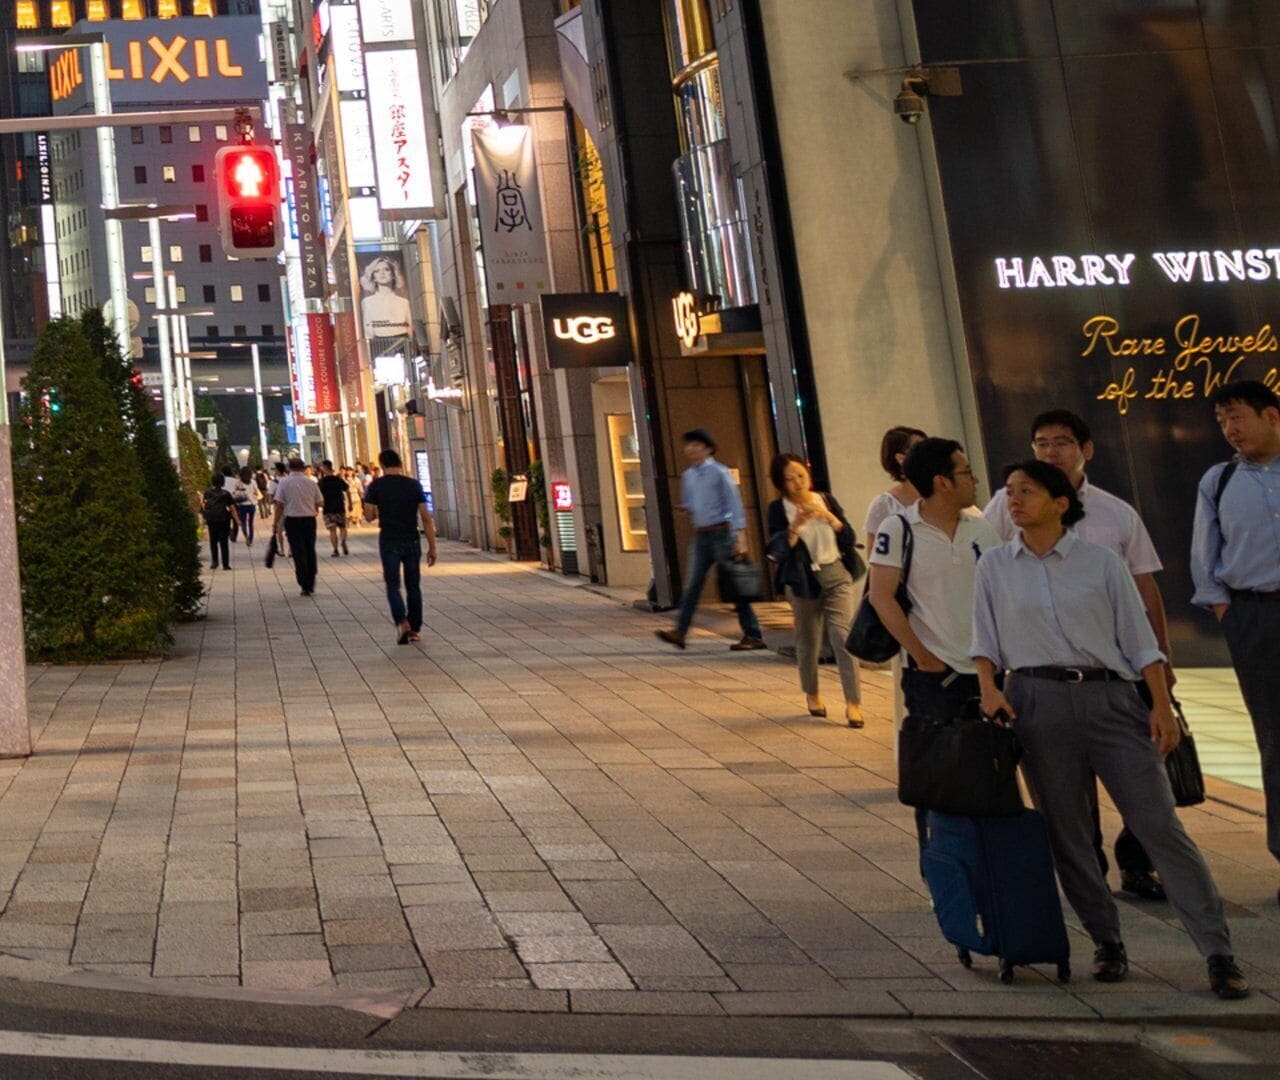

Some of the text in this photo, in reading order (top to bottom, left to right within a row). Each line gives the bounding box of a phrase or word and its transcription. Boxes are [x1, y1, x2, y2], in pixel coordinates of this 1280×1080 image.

[50, 48, 83, 101] LIXIL
[105, 35, 243, 84] LIXIL
[389, 104, 411, 201] 銀座アスター
[294, 132, 317, 290] KIRARITO GINZA
[995, 253, 1136, 288] HARRY
[553, 316, 615, 344] UGG
[672, 291, 697, 348] UGG
[1082, 314, 1279, 371] Rare Jewels
[318, 348, 329, 383] COUTURE
[1097, 368, 1138, 415] of
[1145, 370, 1194, 399] the
[875, 532, 890, 556] 3
